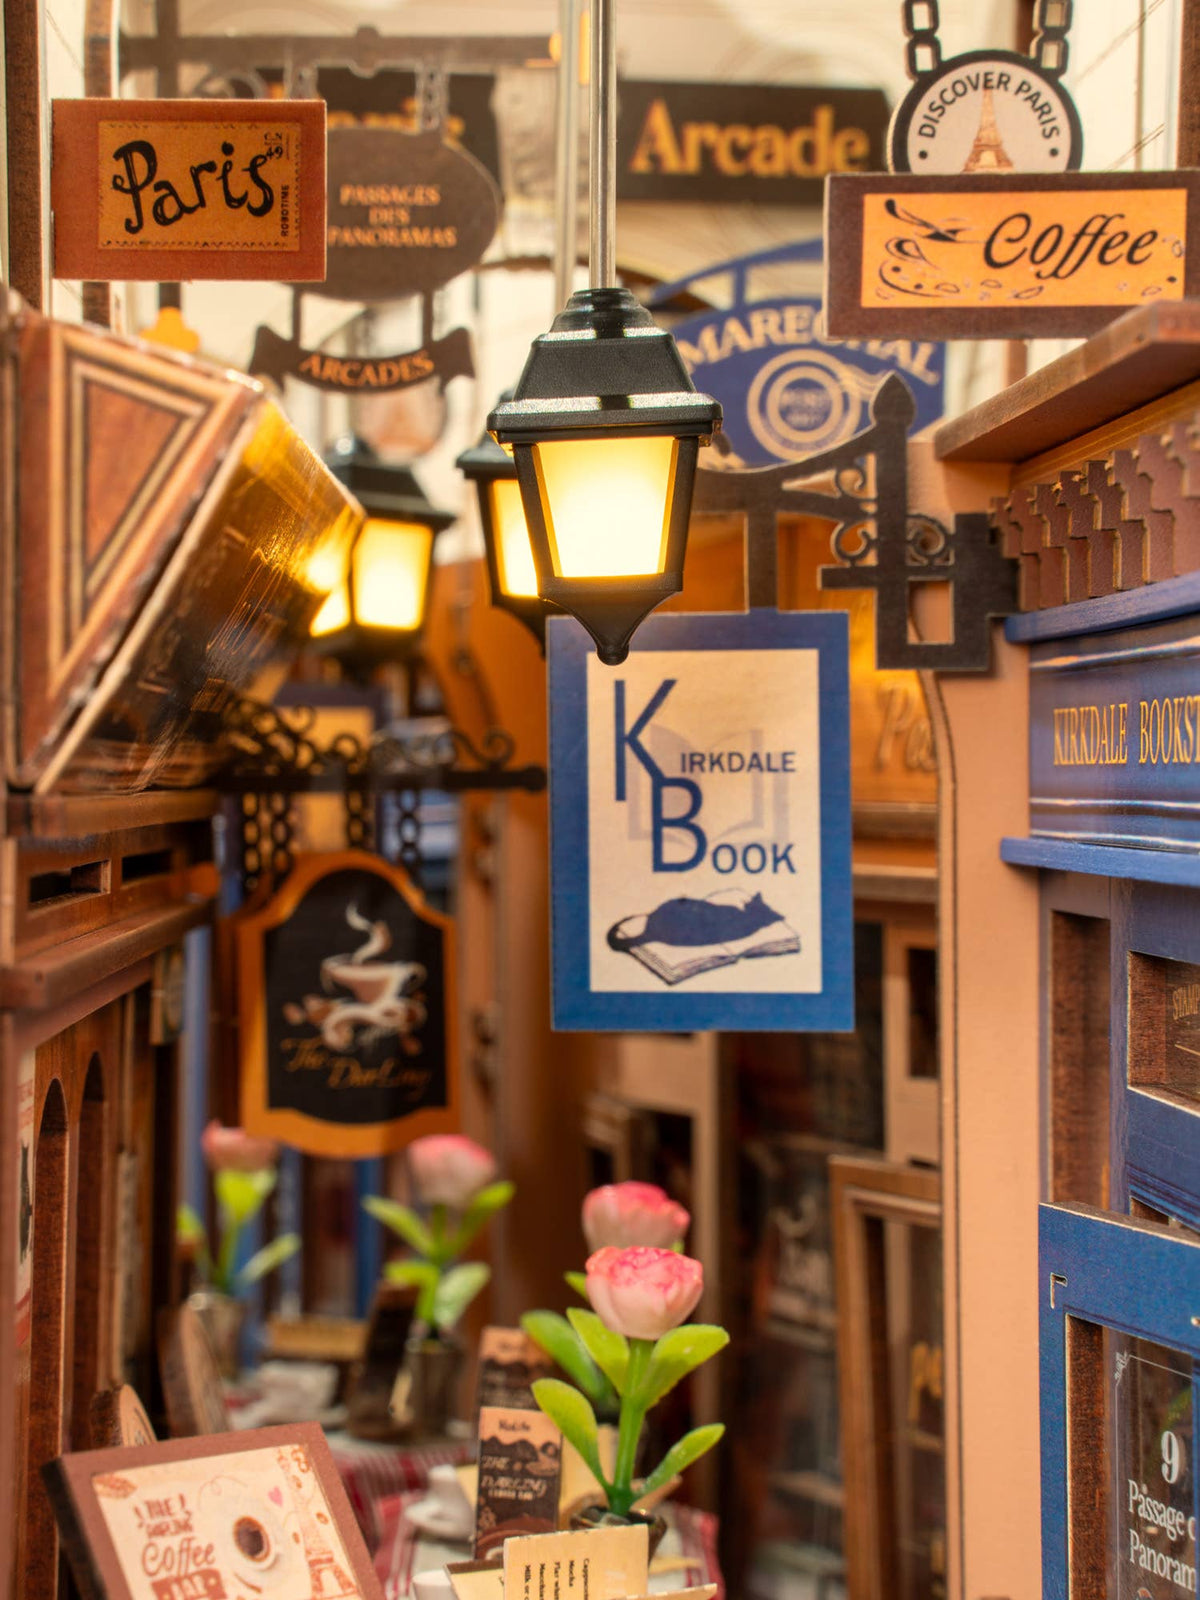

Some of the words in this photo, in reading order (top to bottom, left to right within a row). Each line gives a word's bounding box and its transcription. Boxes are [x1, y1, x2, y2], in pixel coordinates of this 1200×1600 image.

[918, 71, 1012, 139] DISCOVER
[1014, 80, 1061, 139] PARIS
[629, 98, 871, 178] Arcade
[112, 140, 275, 235] Paris
[280, 184, 290, 237] ROBOTIME
[339, 184, 441, 206] PASSAGES
[327, 225, 457, 247] PANORAMAS
[369, 206, 410, 225] DES
[983, 212, 1160, 280] Coffee
[300, 350, 434, 386] ARCADES
[1053, 702, 1128, 766] KIRKDALE
[1161, 1430, 1180, 1485] 9
[1128, 1478, 1186, 1542] Passage
[141, 1536, 216, 1578] Coffee
